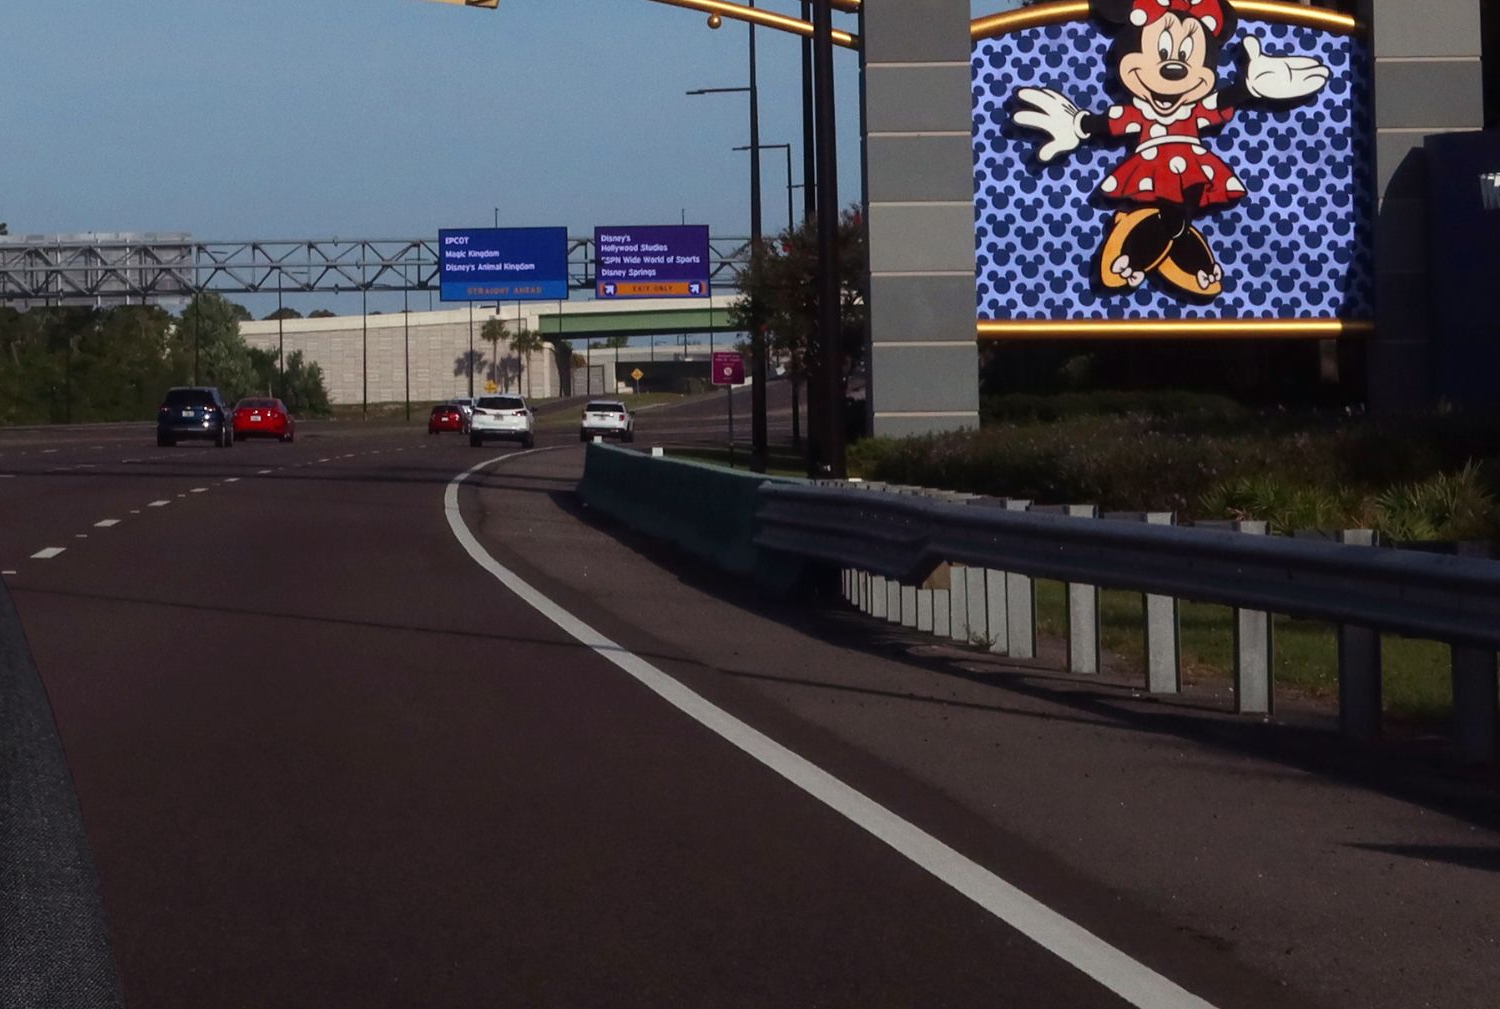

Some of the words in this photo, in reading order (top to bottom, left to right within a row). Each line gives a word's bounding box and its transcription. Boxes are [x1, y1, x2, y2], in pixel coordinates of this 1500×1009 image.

[445, 237, 469, 245] EPCOT
[601, 235, 631, 243] Disney's
[601, 245, 638, 253] Hollywood
[640, 244, 668, 252] Studios
[445, 250, 466, 259] Magic
[468, 250, 500, 259] Kingdom
[622, 256, 641, 264] Wide
[643, 256, 665, 264] World
[666, 256, 674, 264] of
[676, 256, 700, 264] Sports
[445, 263, 475, 272] Disney's
[477, 263, 502, 271] Animal
[503, 263, 535, 271] Kingdom
[601, 269, 627, 277] Disney
[629, 269, 656, 277] Springs
